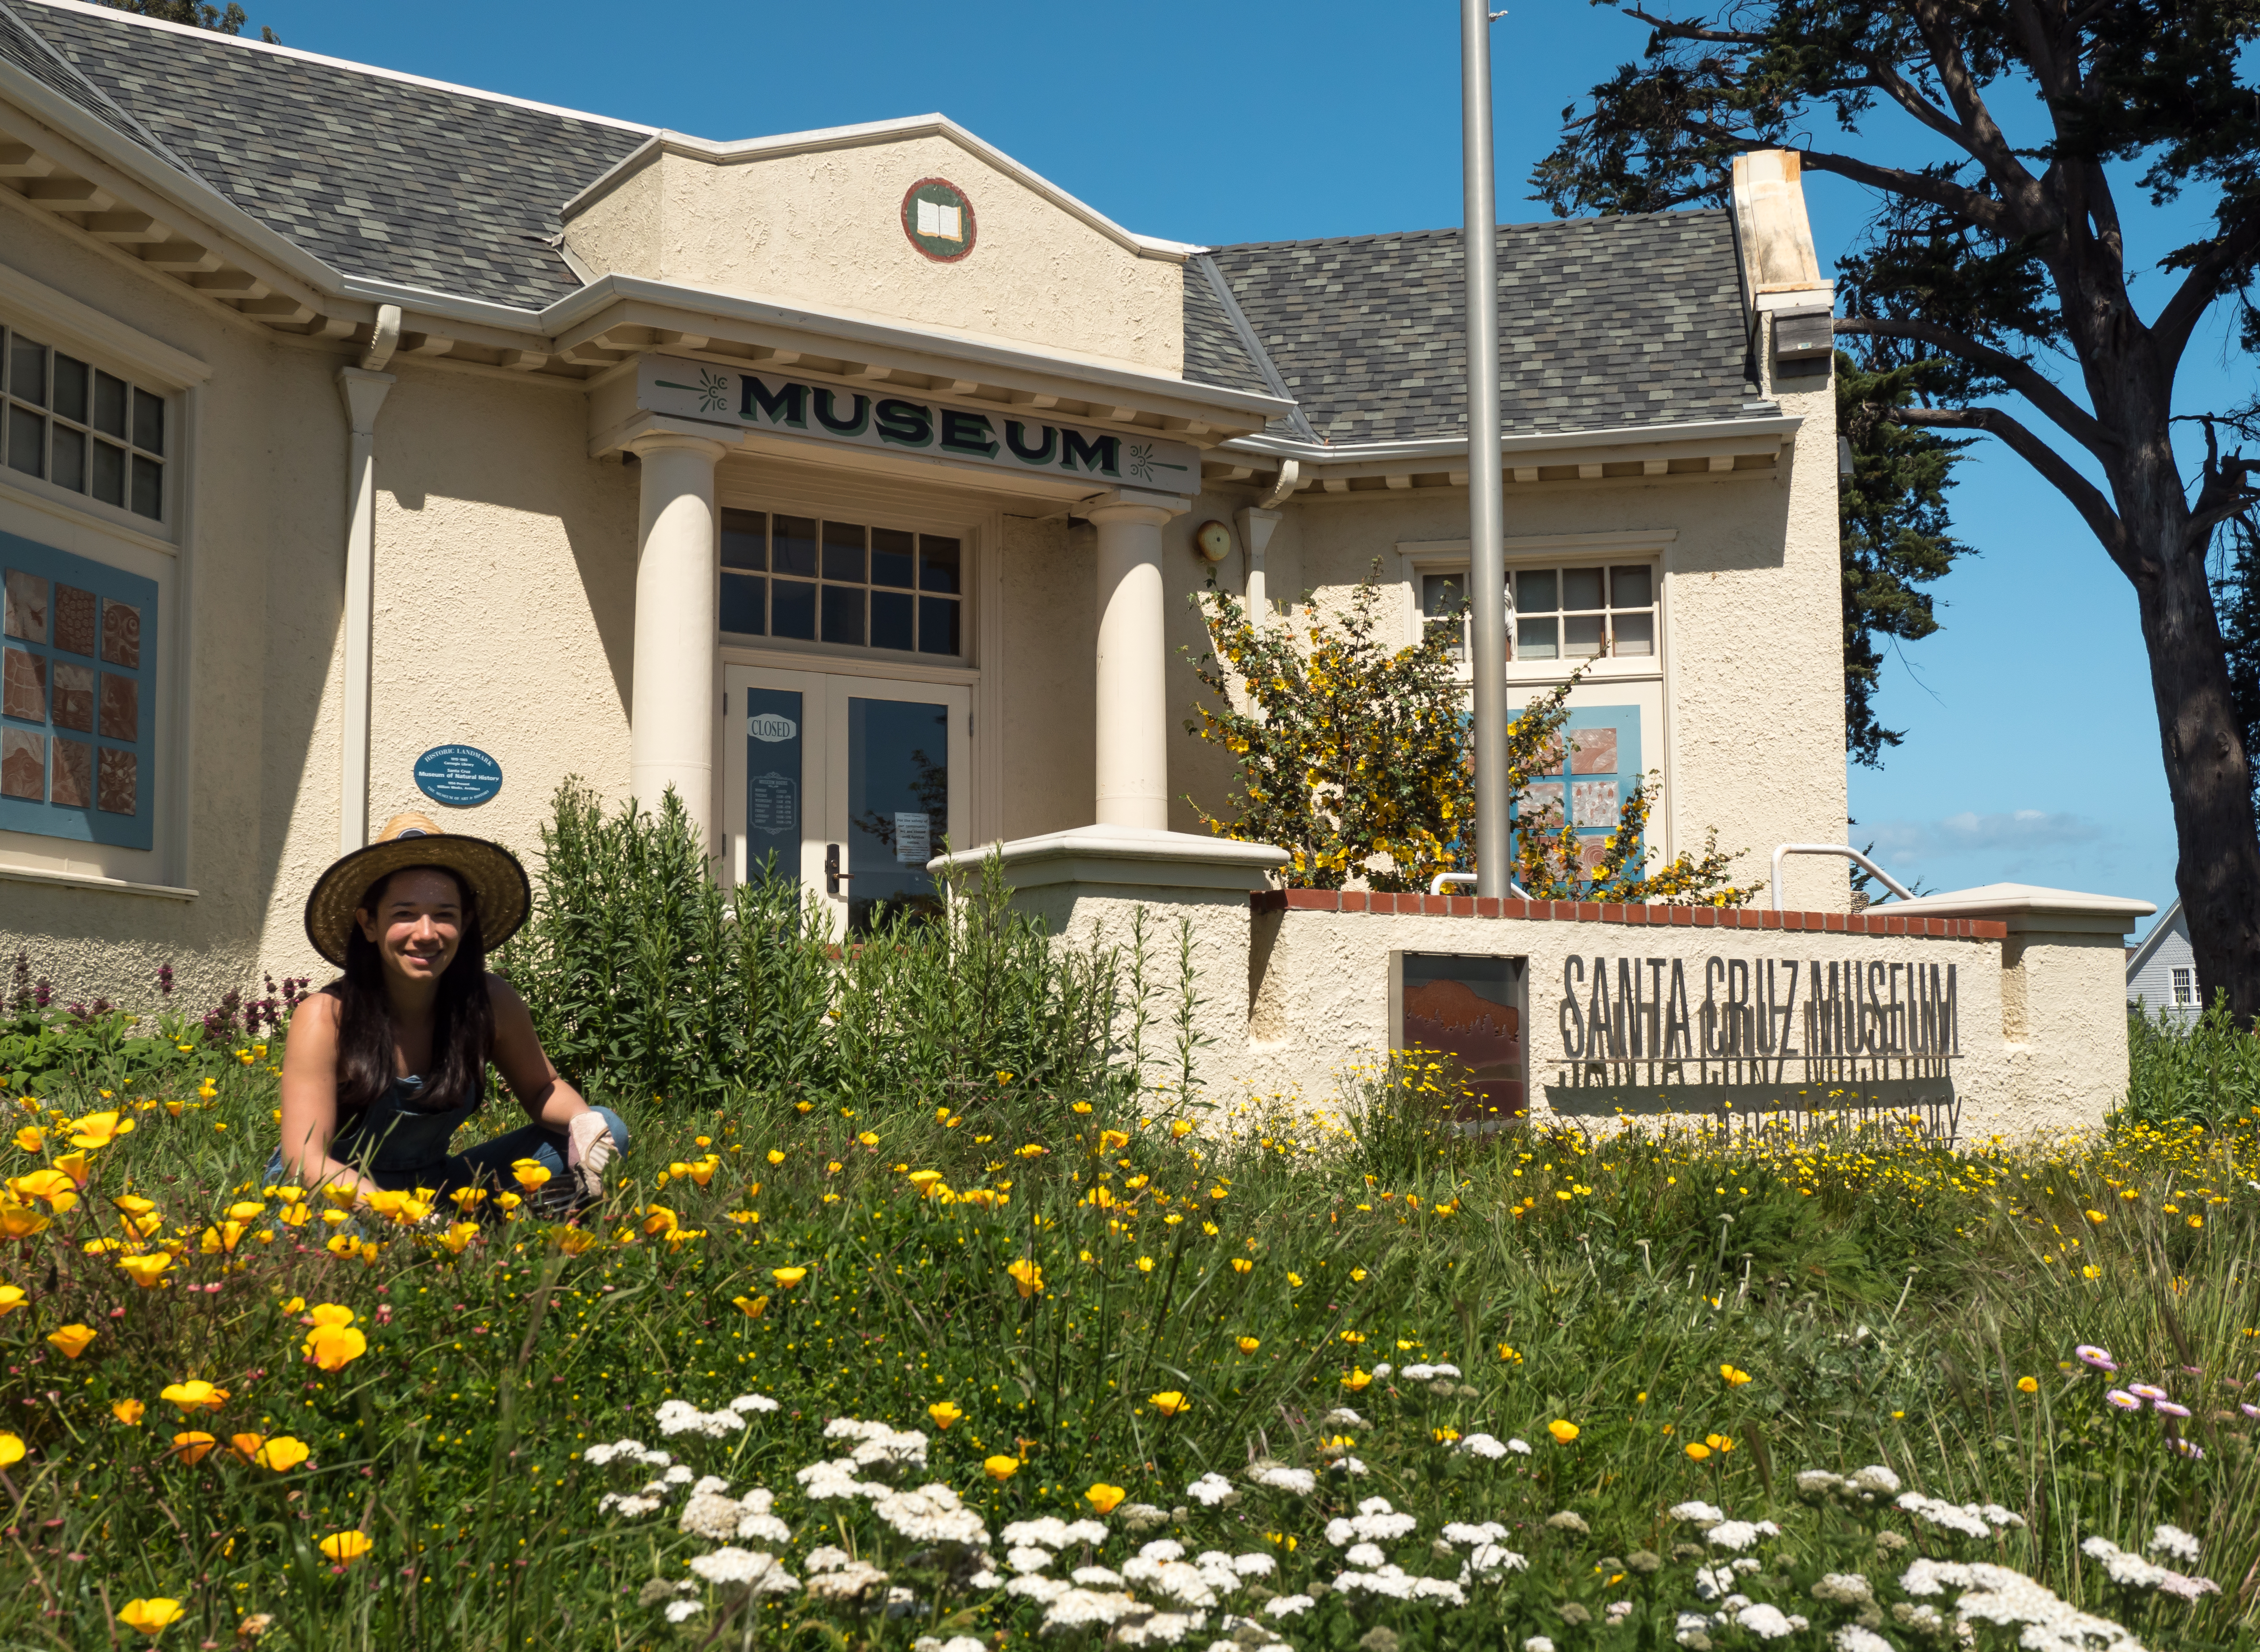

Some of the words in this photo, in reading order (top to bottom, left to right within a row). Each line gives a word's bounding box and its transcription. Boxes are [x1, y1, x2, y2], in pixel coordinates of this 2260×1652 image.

[737, 374, 1122, 478] MUSEUM
[752, 720, 790, 737] CLOSED
[424, 748, 455, 762] HISTORIC
[457, 748, 493, 767] LANDMARK
[474, 790, 490, 799] HISTORY
[1563, 954, 1692, 1059] SANTA
[1705, 956, 1799, 1057] CRUZ
[1810, 959, 1959, 1055] MUSEUM
